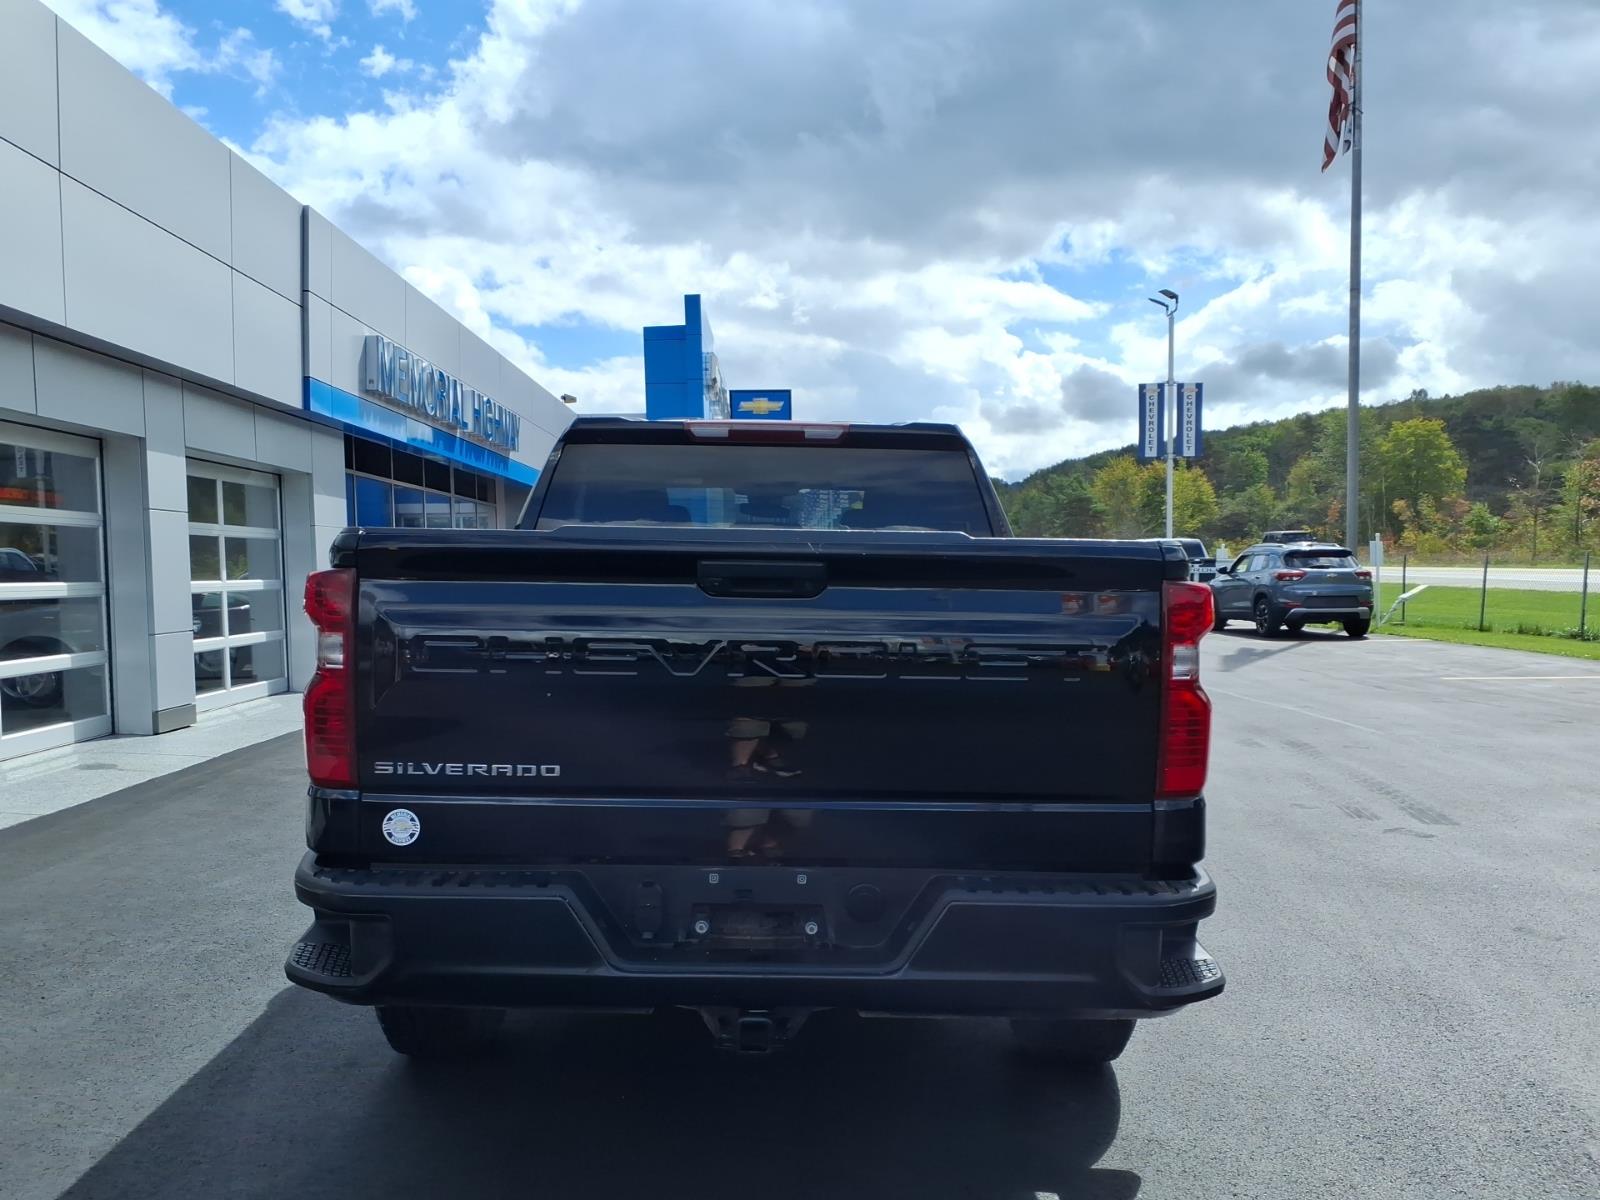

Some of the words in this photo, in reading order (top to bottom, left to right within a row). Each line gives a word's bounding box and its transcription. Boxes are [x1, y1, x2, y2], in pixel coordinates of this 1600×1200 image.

[364, 335, 468, 430] MEMORIAL
[1185, 394, 1193, 451] CHEVROLET
[409, 634, 1108, 682] CHEVROLET
[373, 761, 561, 777] SILVERADO
